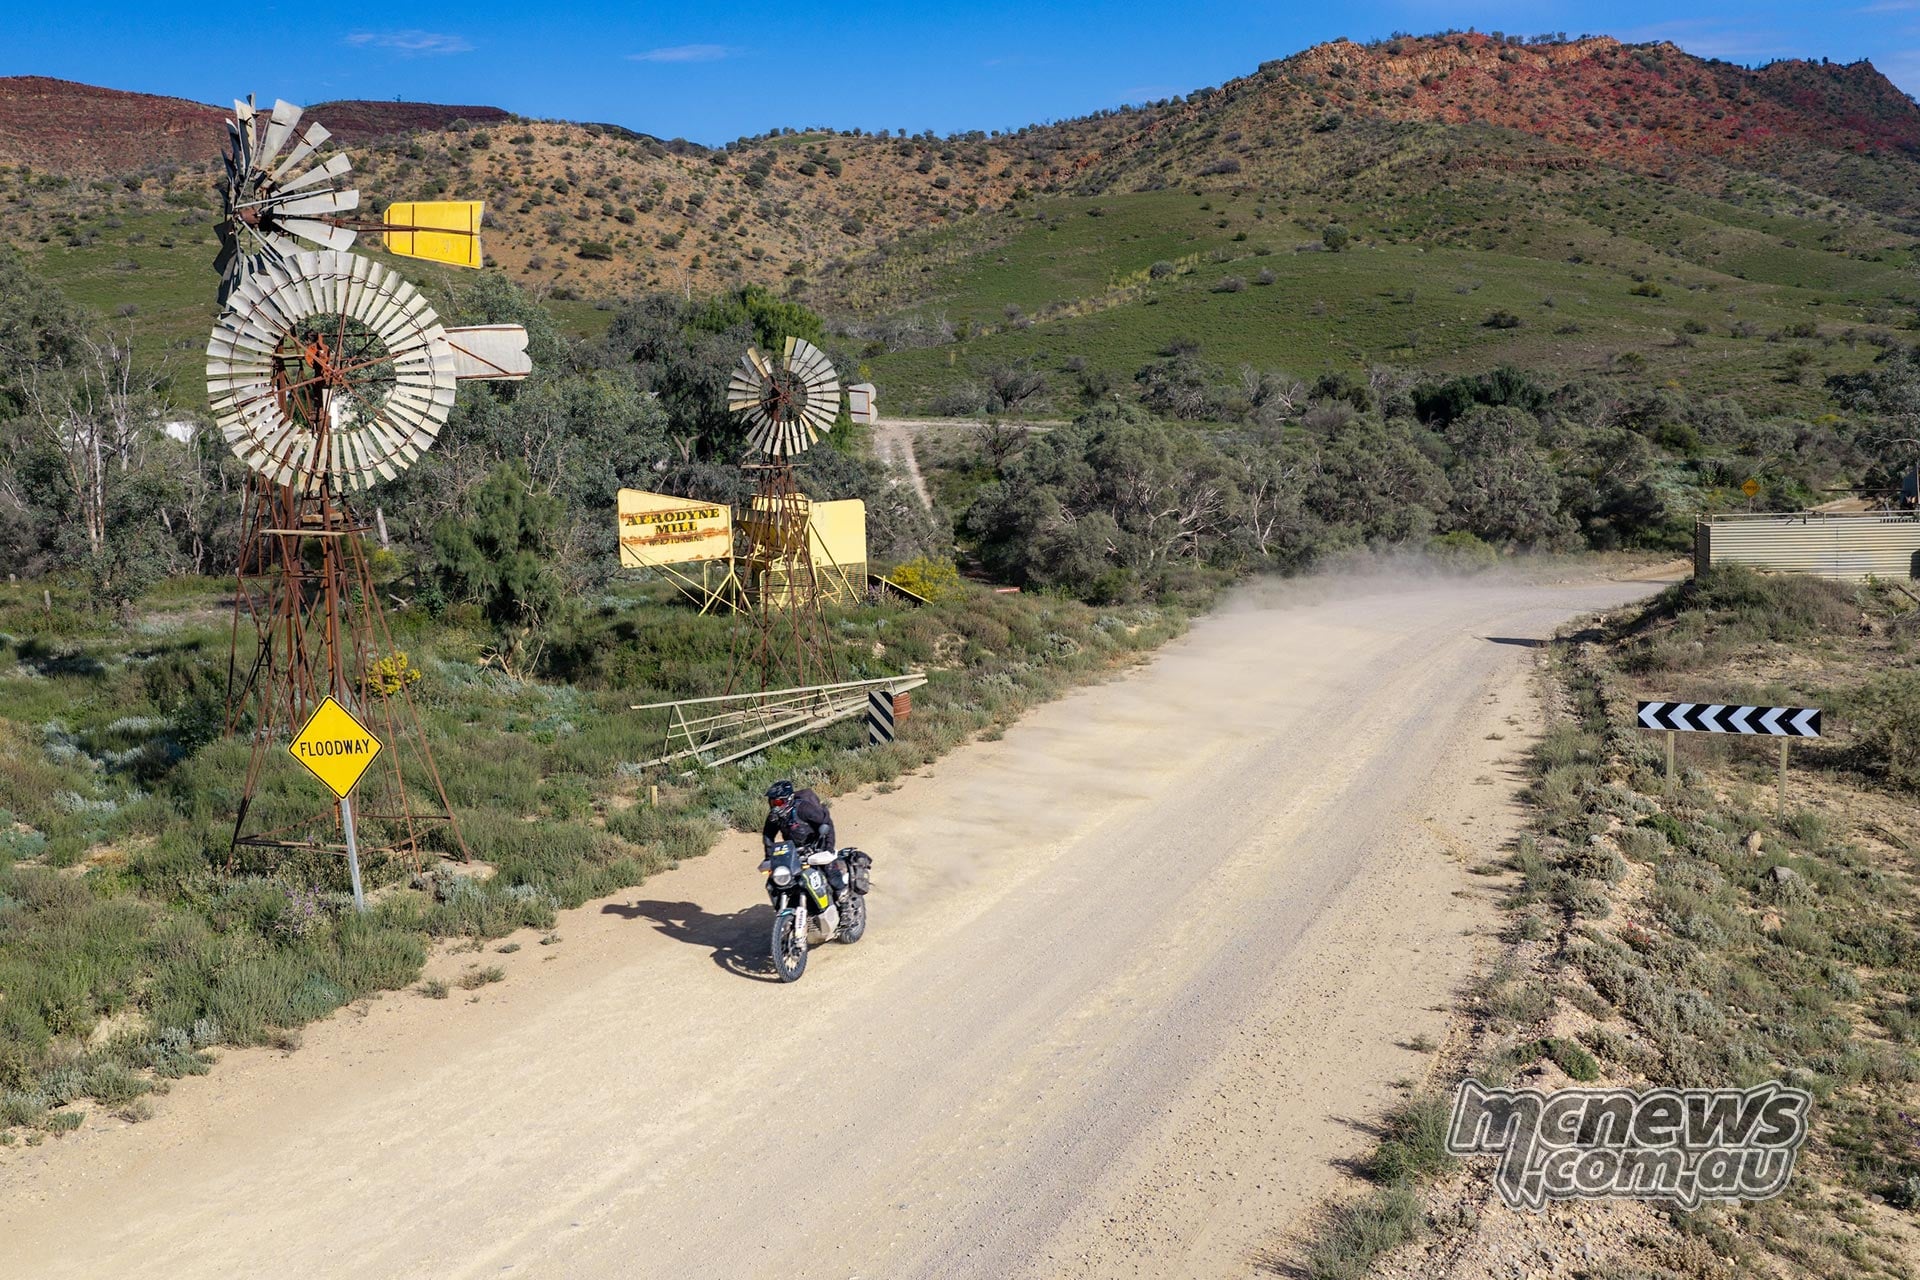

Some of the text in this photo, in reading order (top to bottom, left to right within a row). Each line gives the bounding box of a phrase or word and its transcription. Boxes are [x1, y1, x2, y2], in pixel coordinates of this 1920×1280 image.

[625, 508, 720, 526] AERODYNE
[655, 521, 698, 535] MILL
[300, 739, 370, 757] FLOODWAY
